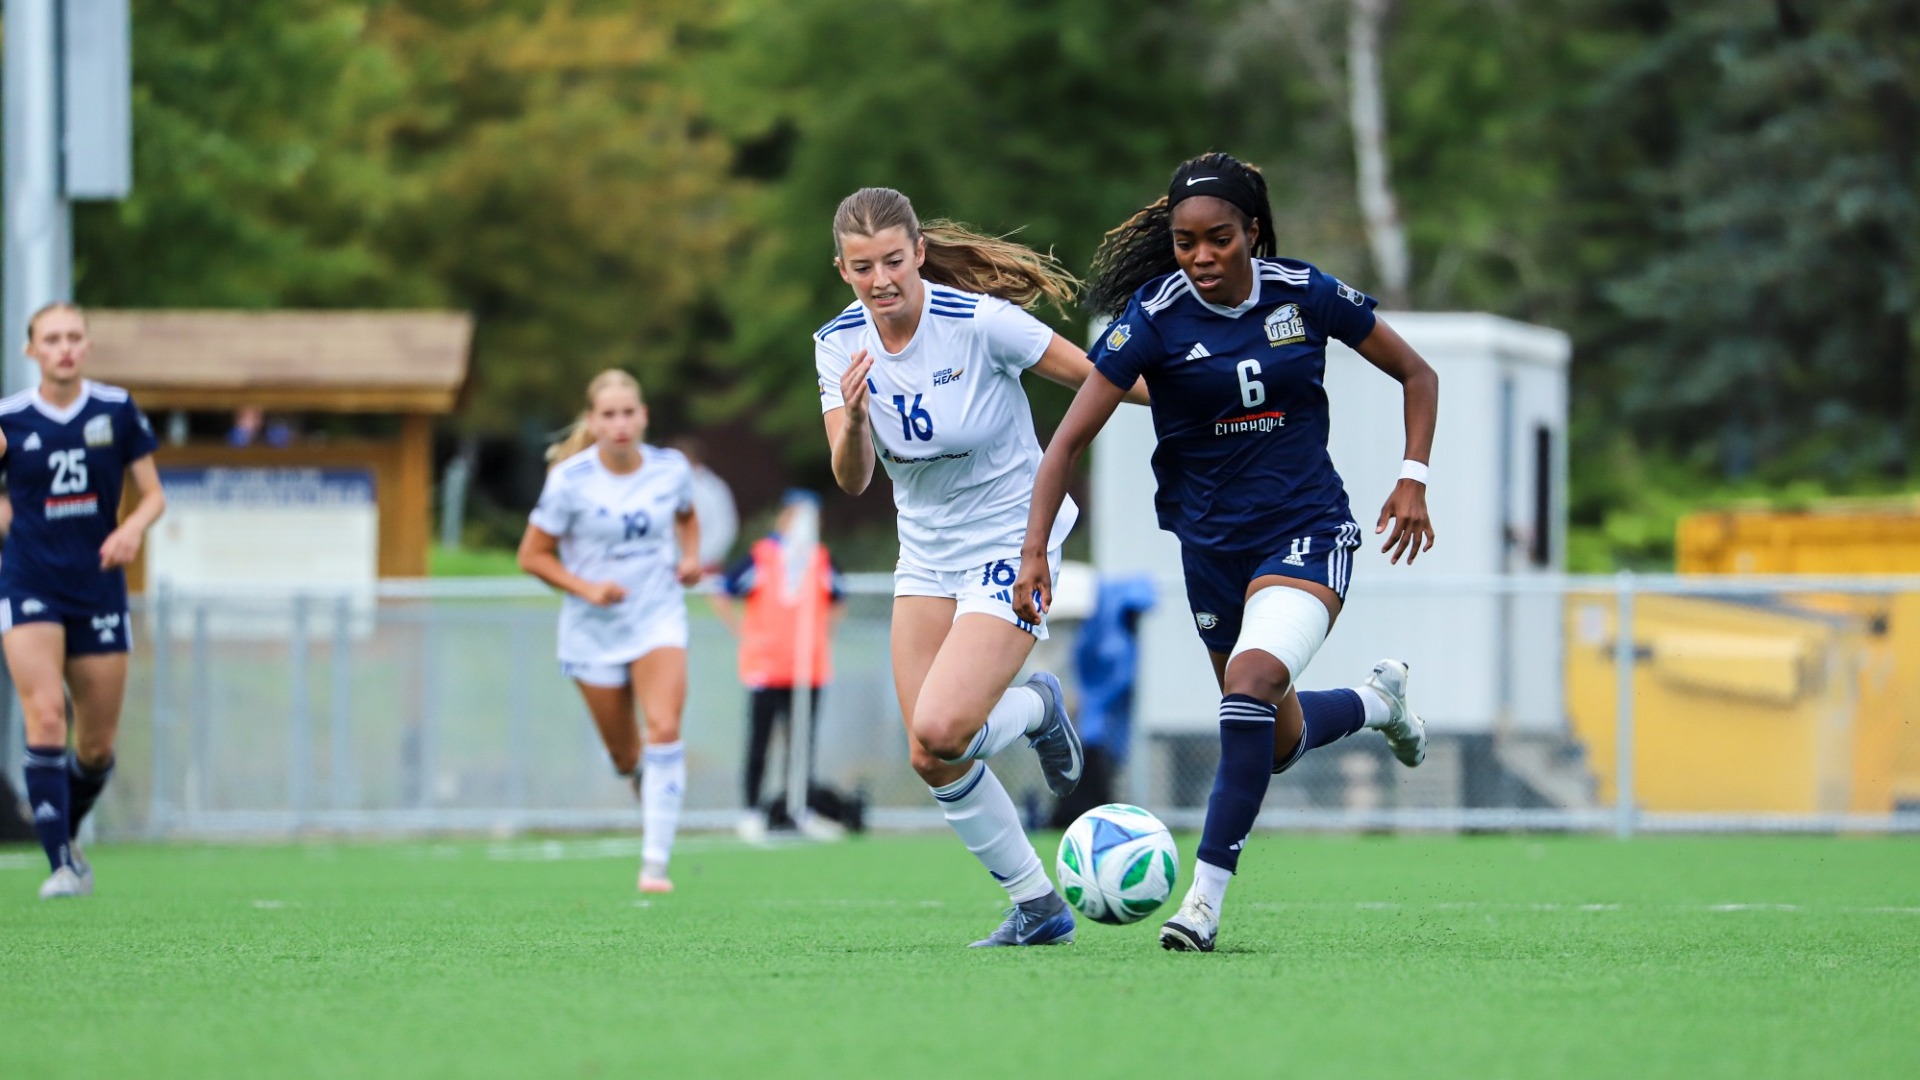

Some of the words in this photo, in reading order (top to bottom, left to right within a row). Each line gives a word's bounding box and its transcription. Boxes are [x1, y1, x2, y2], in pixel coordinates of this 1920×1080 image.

[1264, 317, 1305, 342] UBC
[1237, 359, 1265, 408] 6
[893, 393, 933, 441] 16
[48, 448, 88, 495] 25
[982, 559, 1016, 587] 16
